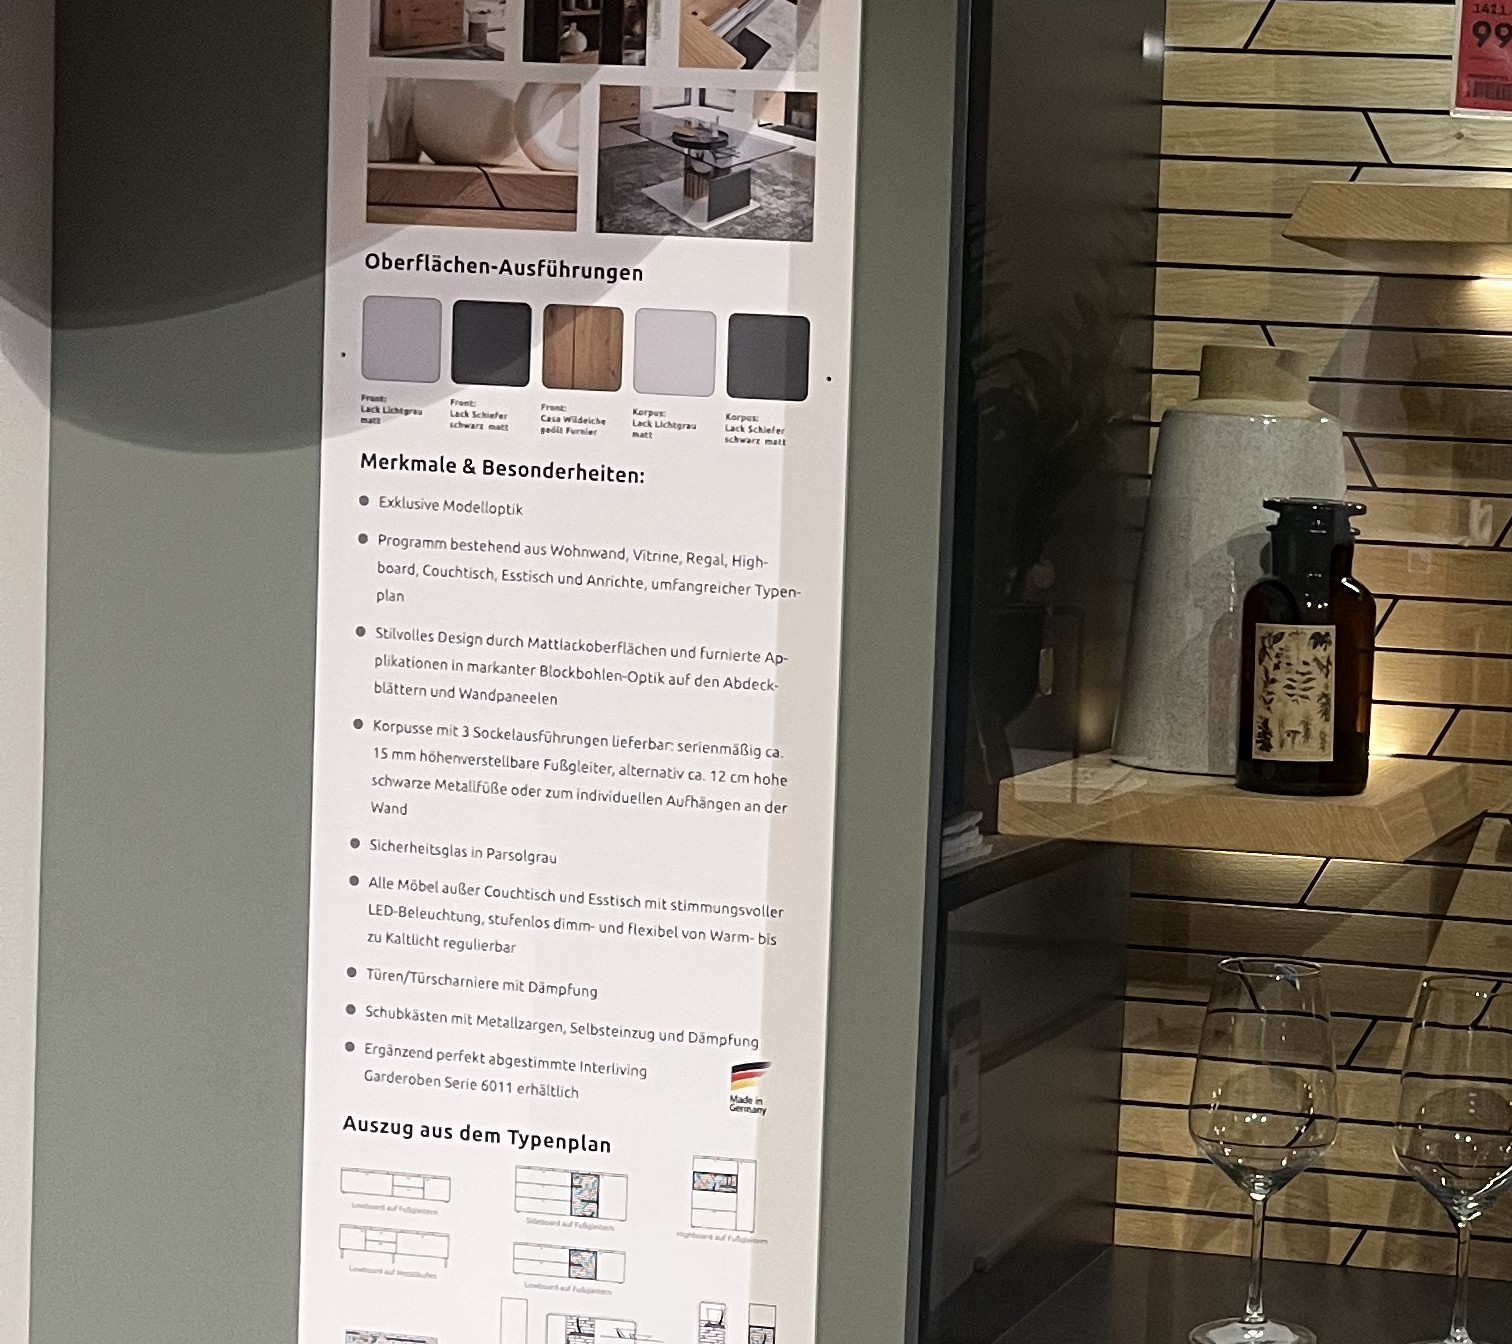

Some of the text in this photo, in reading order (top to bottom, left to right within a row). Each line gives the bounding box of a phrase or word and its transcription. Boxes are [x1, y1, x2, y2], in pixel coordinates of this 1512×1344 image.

[365, 252, 643, 284] Oberflächen-Ausführungen
[360, 452, 645, 484] Merkmale & Besonderheiten:
[379, 495, 523, 517] Exklusive Modelloptik
[378, 533, 769, 571] Programm bestehend aus Wohnwand, Vitrine, Regal, High-
[376, 588, 405, 604] plan
[377, 560, 801, 600] board, Couchtisch, Esstisch und Anrichte, umfangreicher Typen-
[375, 626, 789, 667] Stilvolles Design durch Mattlackoberflächen und furnierte Ap-
[374, 653, 779, 692] plikationen in markanter Blockbohlen-Optik auf den Abdeck-
[374, 680, 558, 706] blättern und Wandpaneelen
[373, 719, 784, 760] Korpusse mit 3 Sockelausführungen lieferbar: serienmäßig ca.
[374, 747, 788, 787] 15 mm höhenverstellbare Fußgleiter, alternativ ca. 12 cm hohe
[370, 801, 408, 816] Wand
[371, 774, 788, 814] schwarze Metallfüße oder zum individuellen Aufhängen an der
[369, 838, 557, 866] Sicherheitsglas in Parsolgrau
[368, 875, 784, 918] Alle Möbel außer Couchtisch und Esstisch mit stimmungsvoller
[367, 931, 517, 954] zu Kaltlicht regulierbar
[368, 903, 777, 946] LED-Beleuchtung, stufenlos dimm- und flexibel von Warm- bis
[366, 967, 598, 1001] Türen/Türscharniere mit Dämpfung
[365, 1005, 759, 1051] Schubkästen mit Metallzargen, Selbsteinzug und Dämpfung
[364, 1042, 647, 1080] Ergänzend perfekt abgestimmte Interliving
[364, 1069, 579, 1099] Garderoben Serie 6011 erhältlich
[342, 1115, 611, 1154] Auszug aus dem Typenplan
